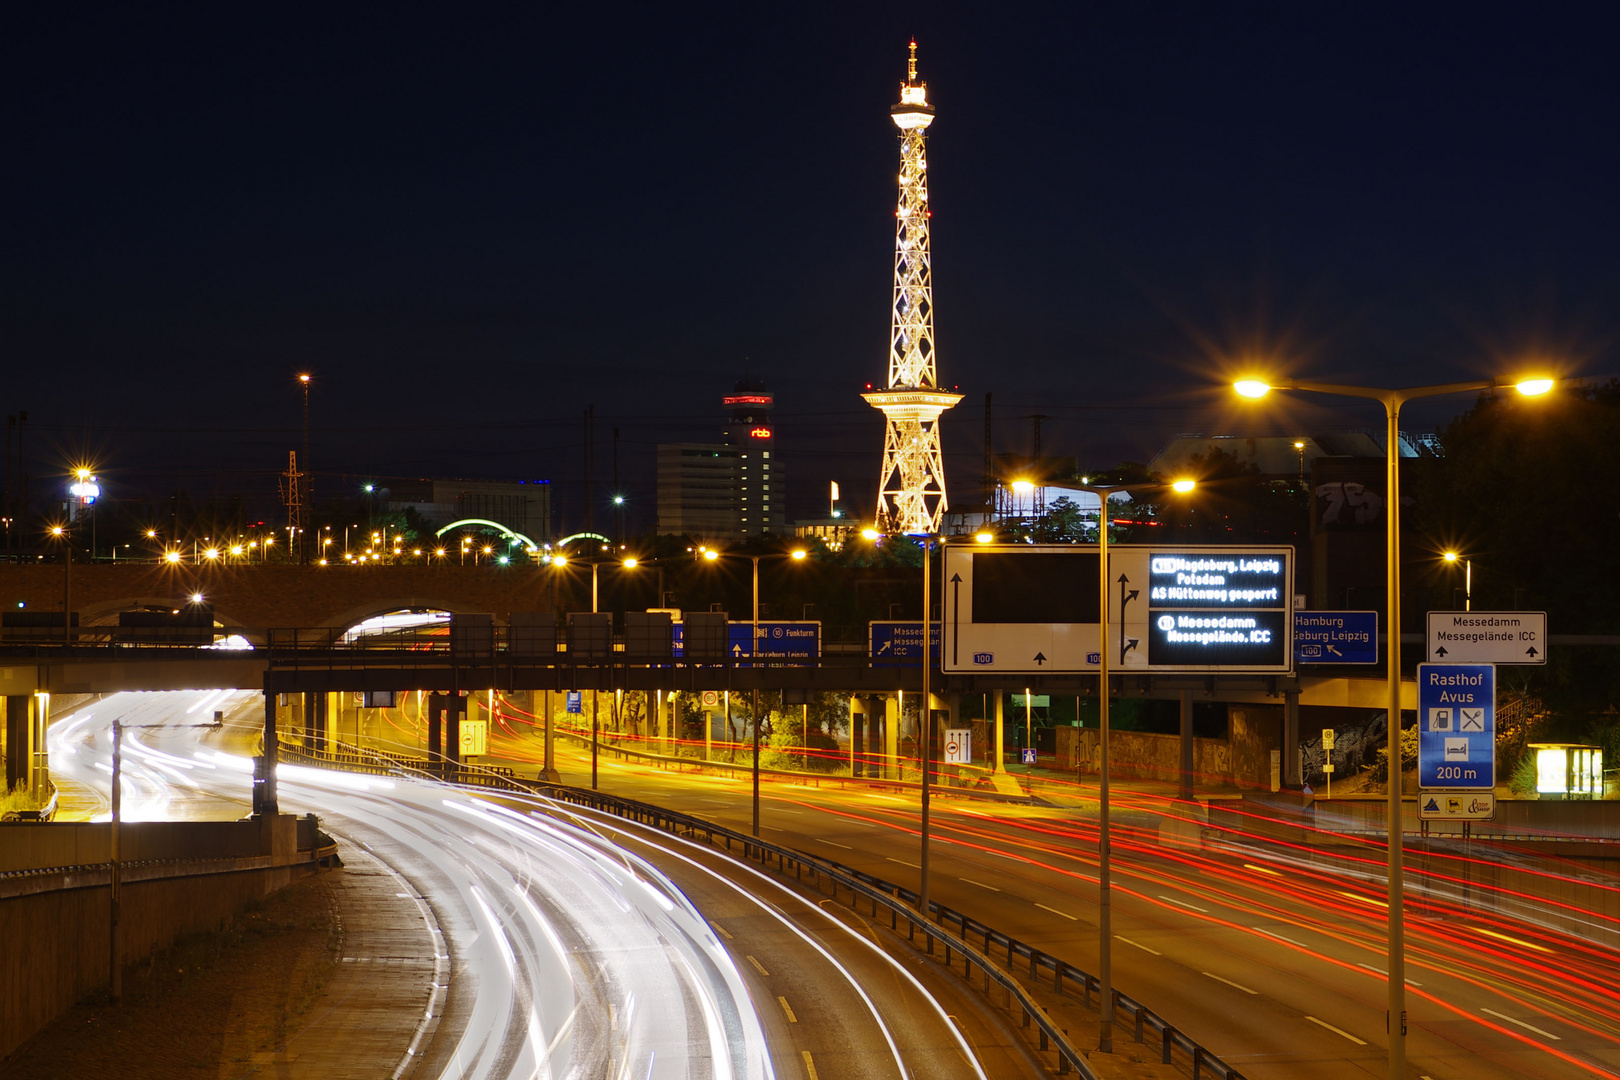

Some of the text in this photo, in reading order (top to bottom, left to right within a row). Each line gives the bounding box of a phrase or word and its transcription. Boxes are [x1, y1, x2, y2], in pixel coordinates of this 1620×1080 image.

[751, 428, 771, 438] rbb
[1176, 558, 1238, 574] Magdeburg,
[1240, 558, 1279, 574] Leipzig
[1177, 572, 1225, 585] Potsdam
[1152, 586, 1278, 602] AS Hüttenweg gesperrt
[1177, 615, 1256, 628] Messedamm
[1295, 616, 1343, 628] Hamburg
[1453, 617, 1521, 627] Messedamm
[786, 629, 814, 637] Funkturm
[1167, 630, 1271, 645] Messegelände, ICC
[1331, 630, 1369, 643] Leipzig
[1437, 631, 1536, 642] Messegelände ICC
[894, 647, 907, 655] ICC
[976, 654, 990, 663] 100
[1429, 673, 1483, 686] Rasthof
[1439, 690, 1474, 703] Avus
[1436, 766, 1477, 779] 200 m
